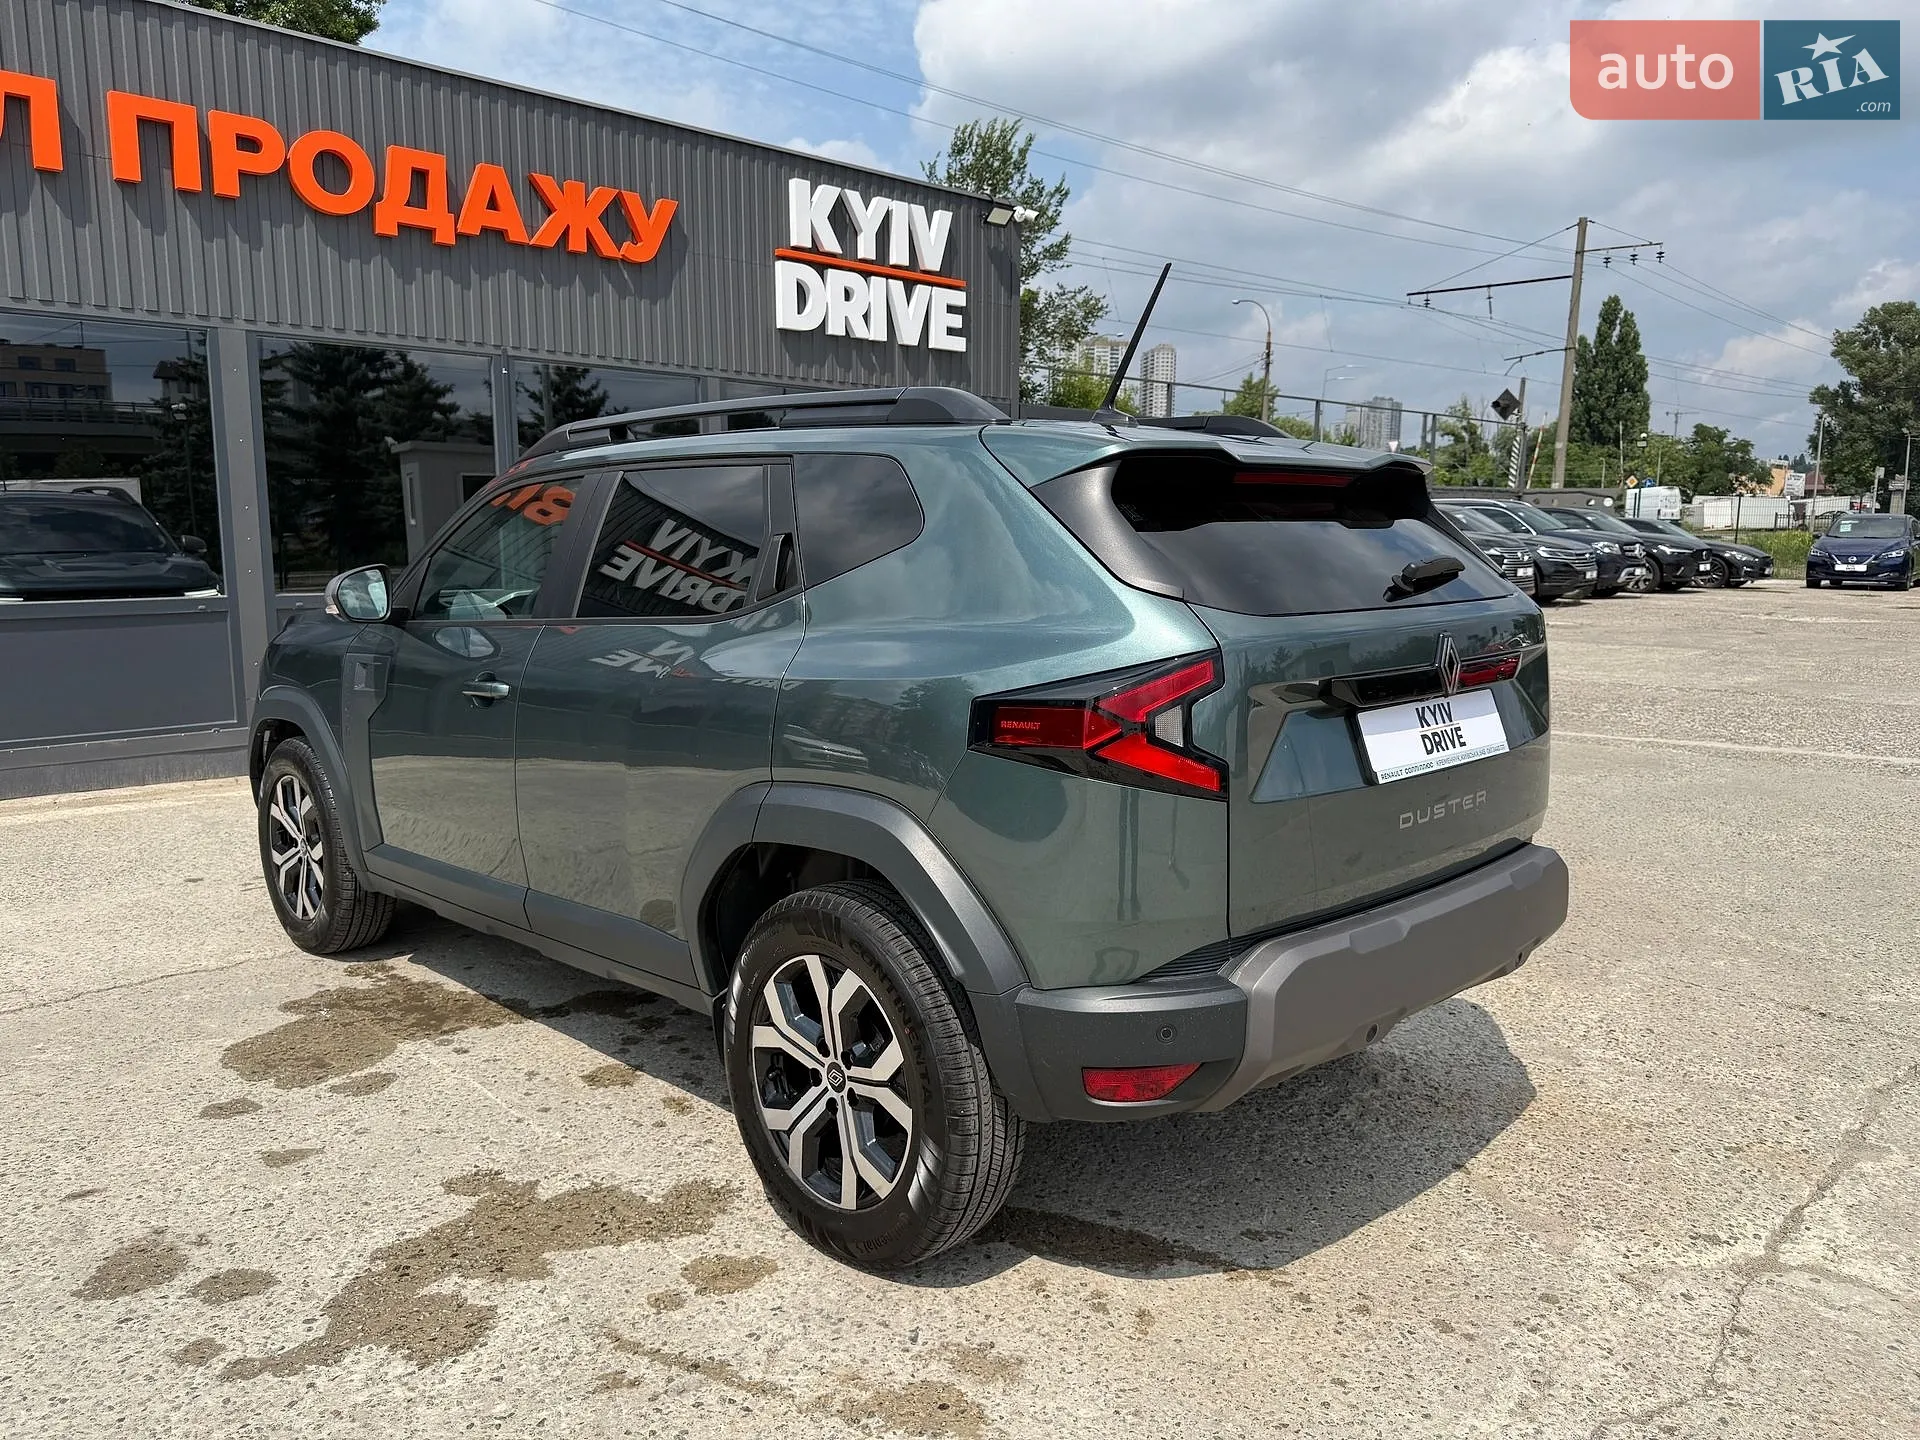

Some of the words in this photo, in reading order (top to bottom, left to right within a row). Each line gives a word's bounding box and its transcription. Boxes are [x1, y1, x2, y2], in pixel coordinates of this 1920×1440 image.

[106, 89, 678, 263] ПРОДАЖУ
[788, 177, 953, 272] KYIV
[775, 260, 967, 352] DRIVE
[1000, 719, 1041, 731] RENAULT
[1415, 701, 1453, 728] KYIV
[1420, 726, 1466, 755] DRIVE
[1381, 769, 1403, 780] RENAULT
[1399, 791, 1488, 829] DUSTER
